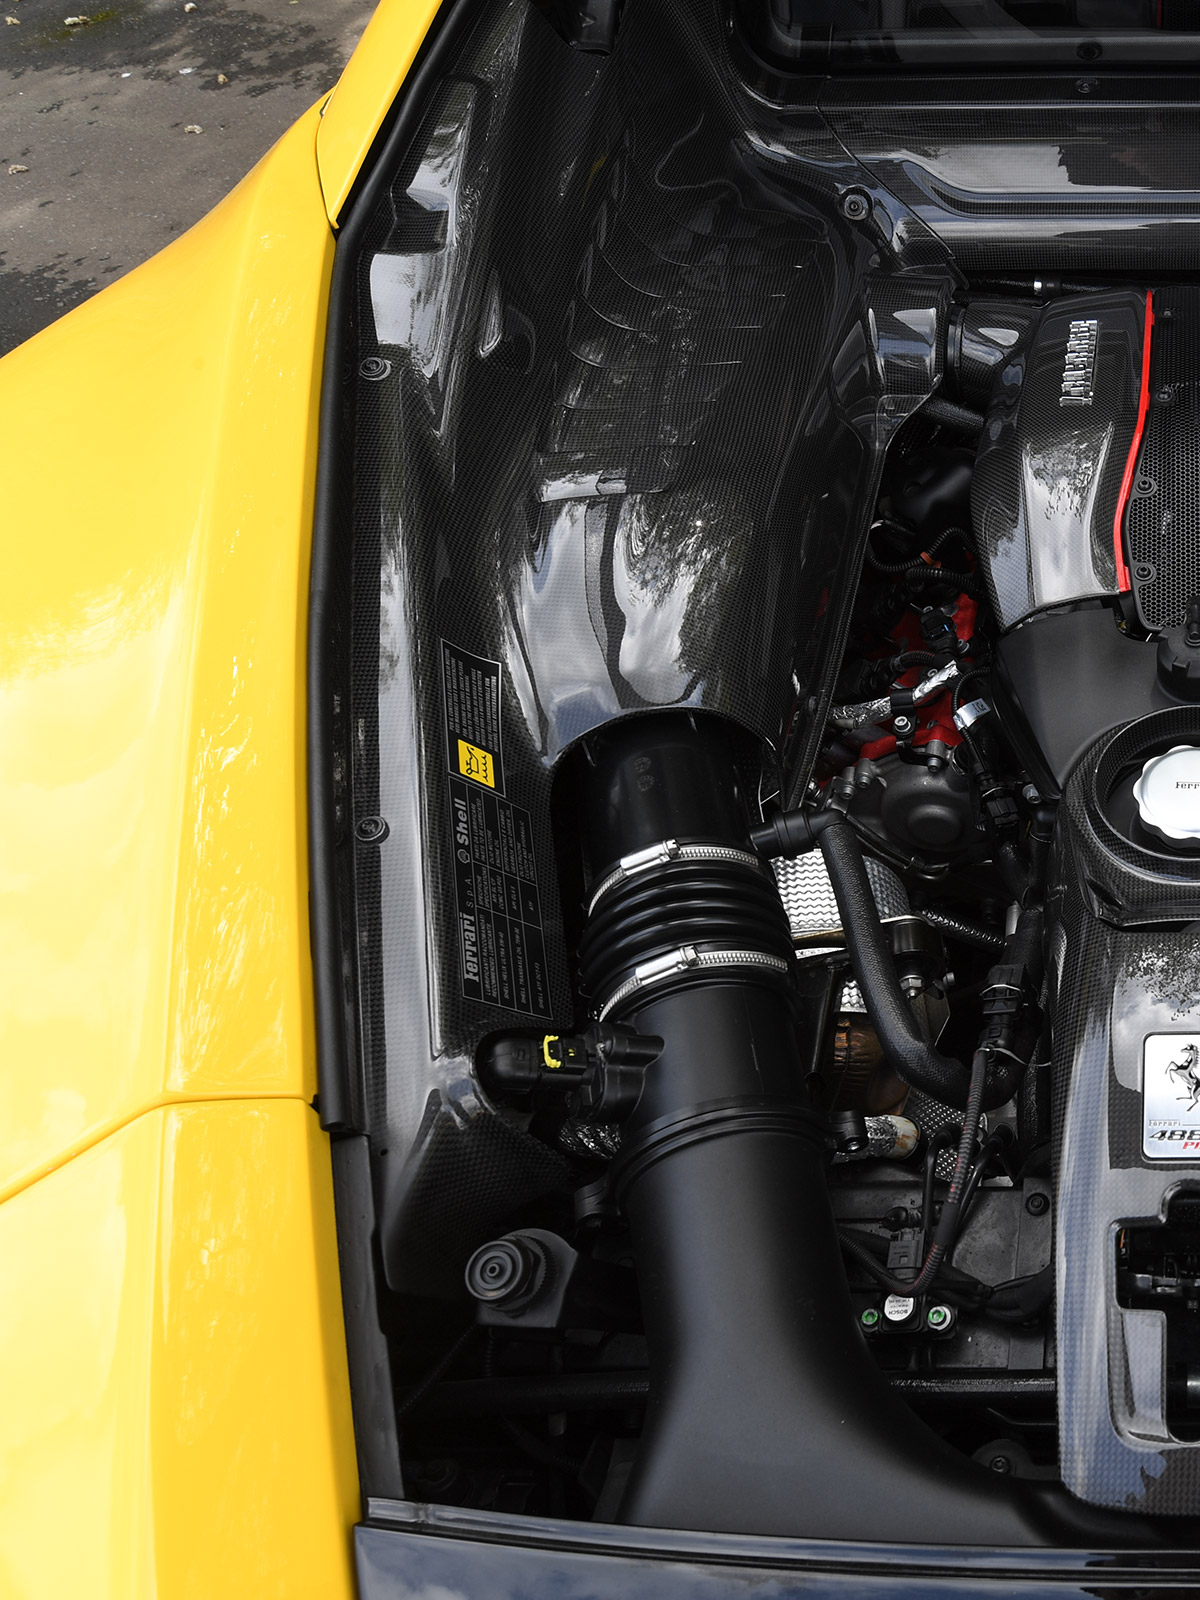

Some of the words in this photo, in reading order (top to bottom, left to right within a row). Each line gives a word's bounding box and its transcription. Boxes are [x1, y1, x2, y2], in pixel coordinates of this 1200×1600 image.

[454, 798, 469, 845] Shell
[464, 875, 475, 908] S.p.A.
[460, 913, 479, 982] Ferrari
[479, 914, 487, 956] RACCOMANDATI
[486, 923, 494, 956] LUBRICANTS
[483, 957, 491, 995] LUBRIFICANTI
[489, 957, 497, 997] RECOMMENDED
